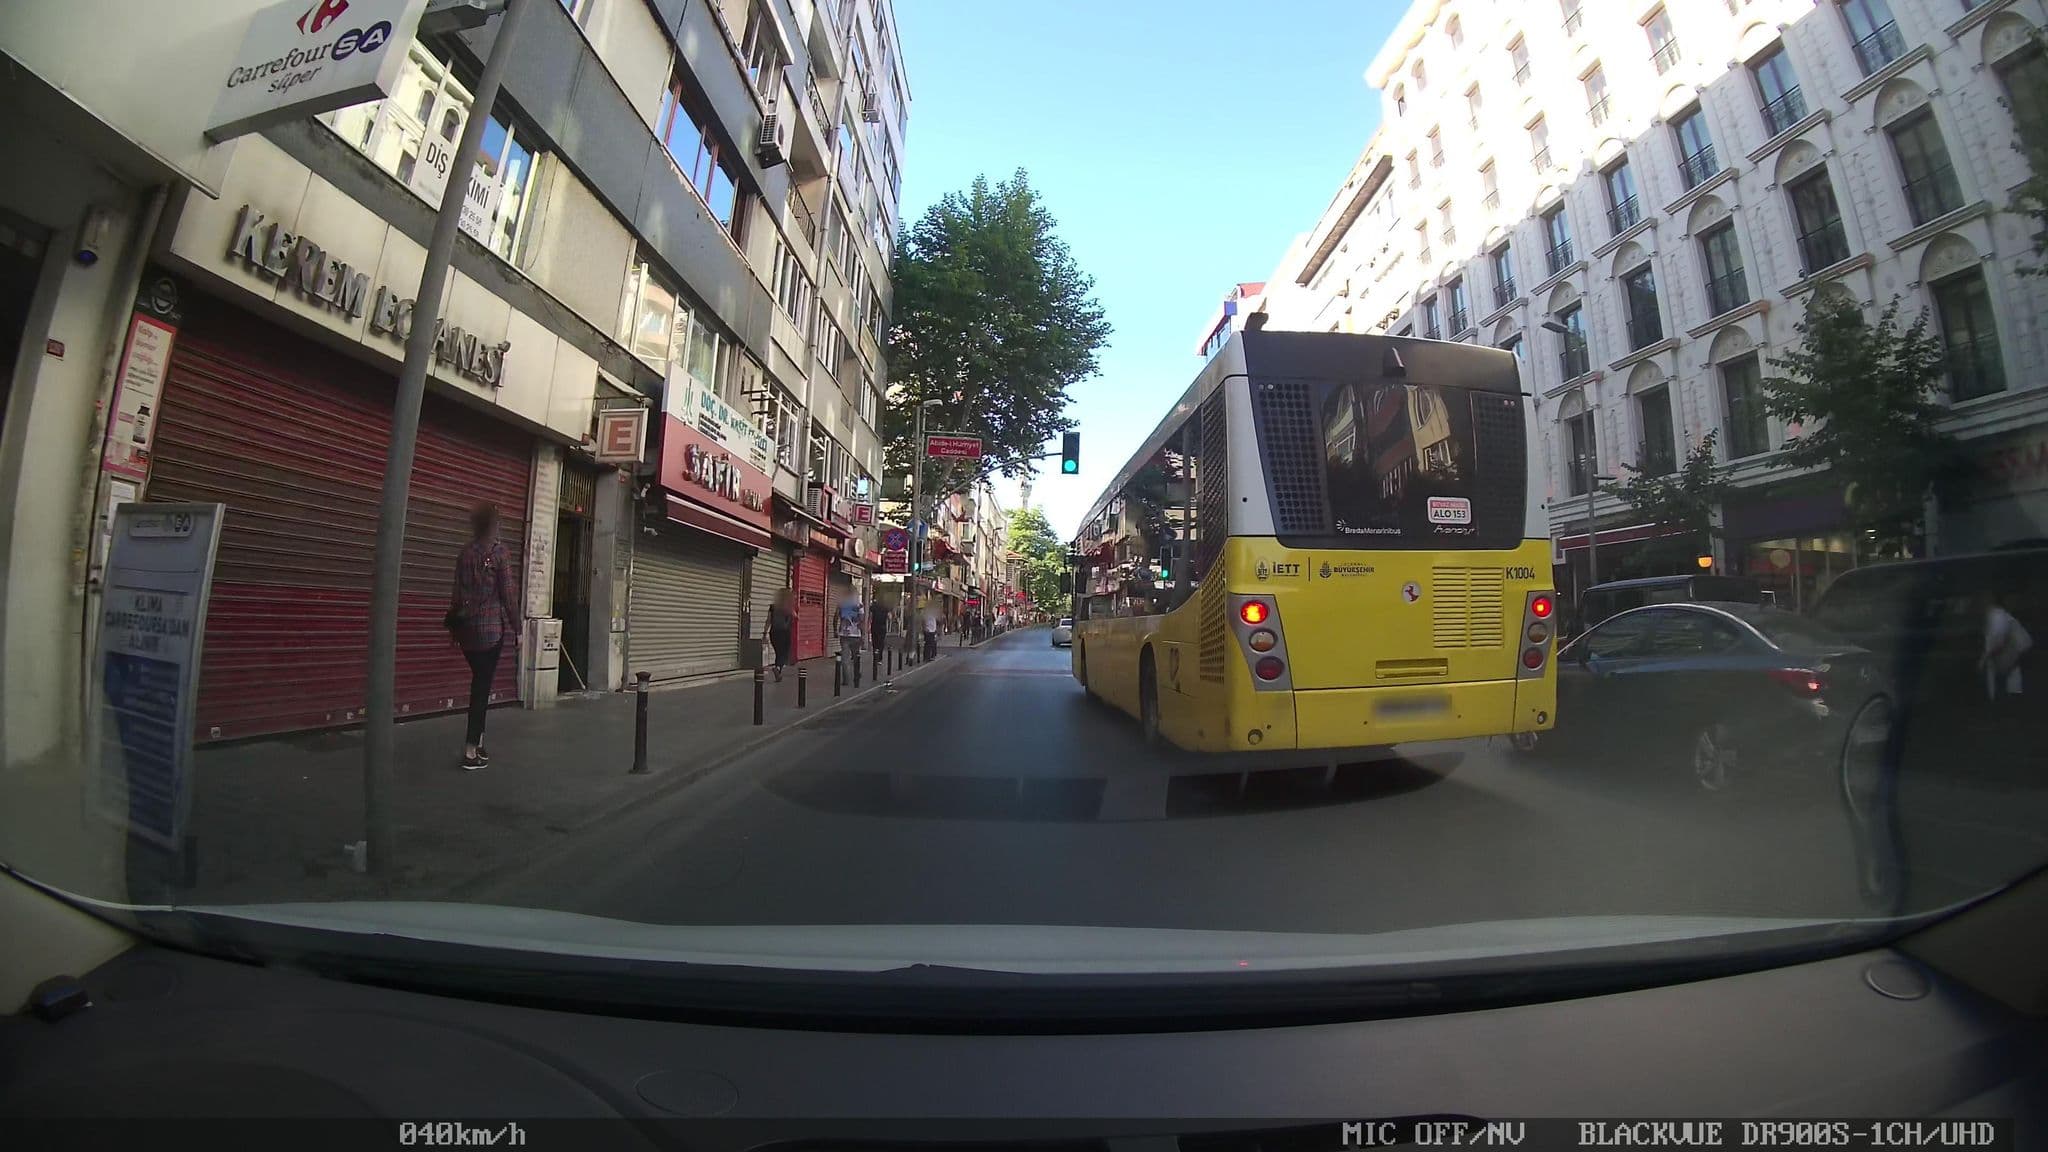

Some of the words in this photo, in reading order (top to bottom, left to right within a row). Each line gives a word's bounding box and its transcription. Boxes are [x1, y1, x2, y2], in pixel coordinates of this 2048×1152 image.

[267, 64, 323, 94] süper
[425, 141, 448, 179] DİŞ
[231, 204, 370, 319] KEREM
[608, 420, 634, 451] E
[1434, 510, 1452, 518] ALO
[1453, 510, 1466, 519] 153
[1273, 561, 1300, 574] İETT
[1506, 567, 1536, 579] K1004
